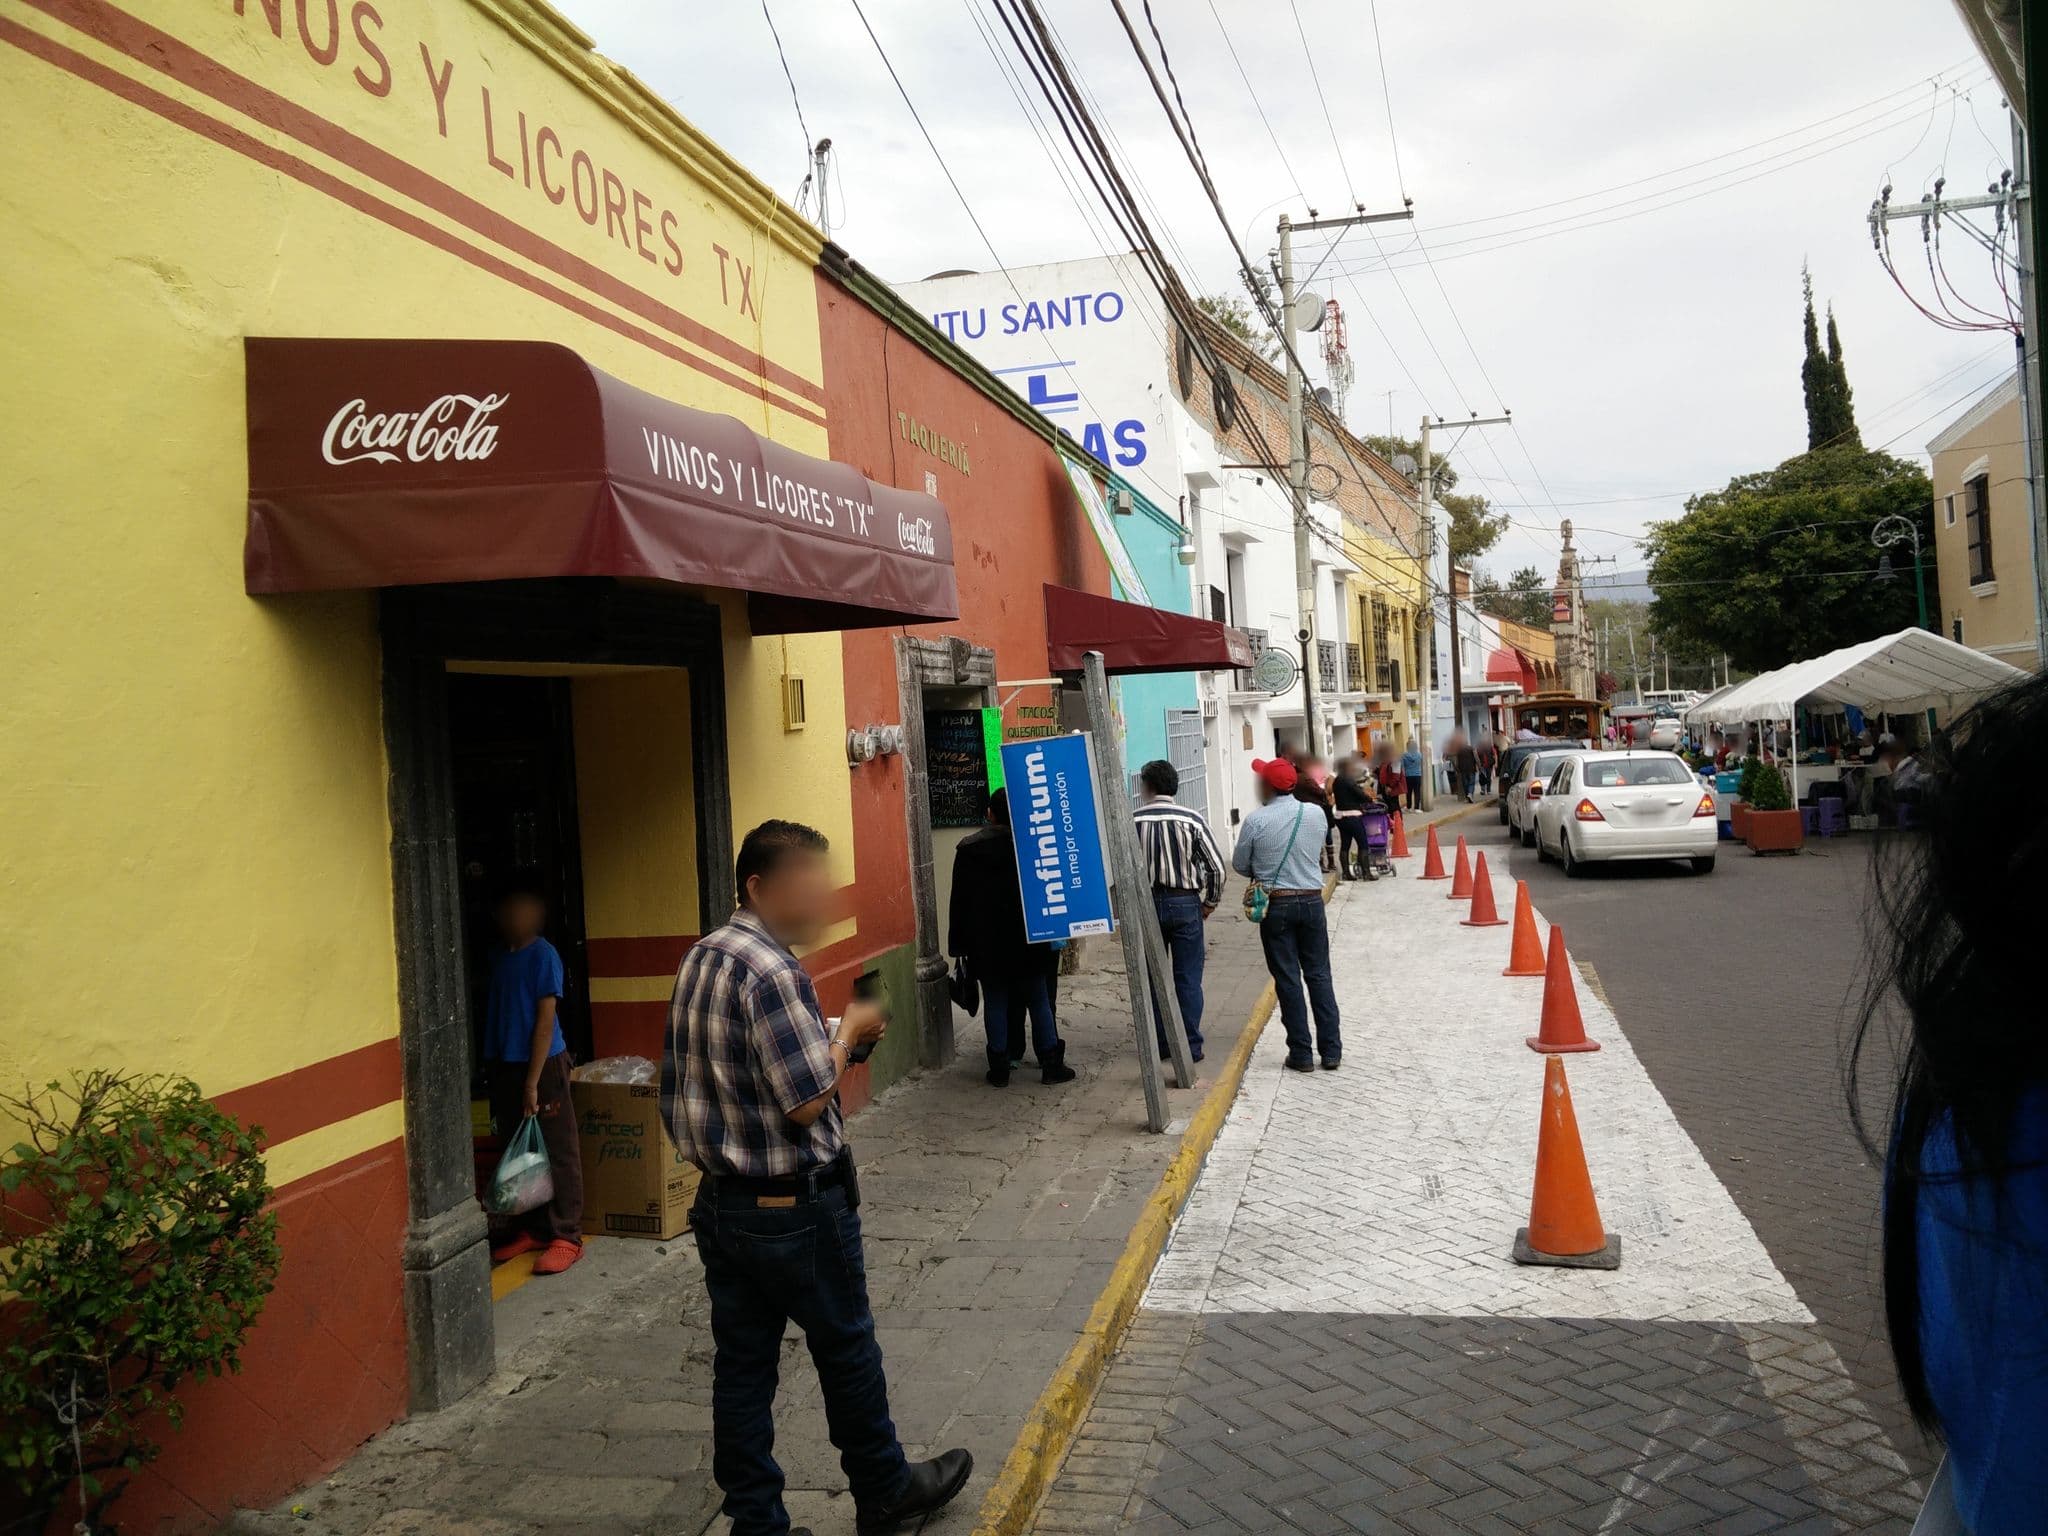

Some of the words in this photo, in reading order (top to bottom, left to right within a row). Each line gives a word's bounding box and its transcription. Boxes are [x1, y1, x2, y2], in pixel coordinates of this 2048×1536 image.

[419, 41, 453, 138] Y
[481, 86, 683, 276] LICORES
[712, 242, 757, 322] TX
[1002, 292, 1124, 335] SANTO
[322, 393, 510, 465] Coca-Cola
[1061, 419, 1147, 470] AS
[642, 427, 724, 495] VINOS
[728, 459, 742, 501] Y
[751, 467, 835, 528] LICORES
[836, 495, 874, 537] "TX"
[1019, 706, 1056, 718] TACOS
[1055, 771, 1073, 832] conexión
[1025, 751, 1068, 916] infinitum
[1065, 836, 1080, 873] mejor
[1071, 877, 1082, 888] la
